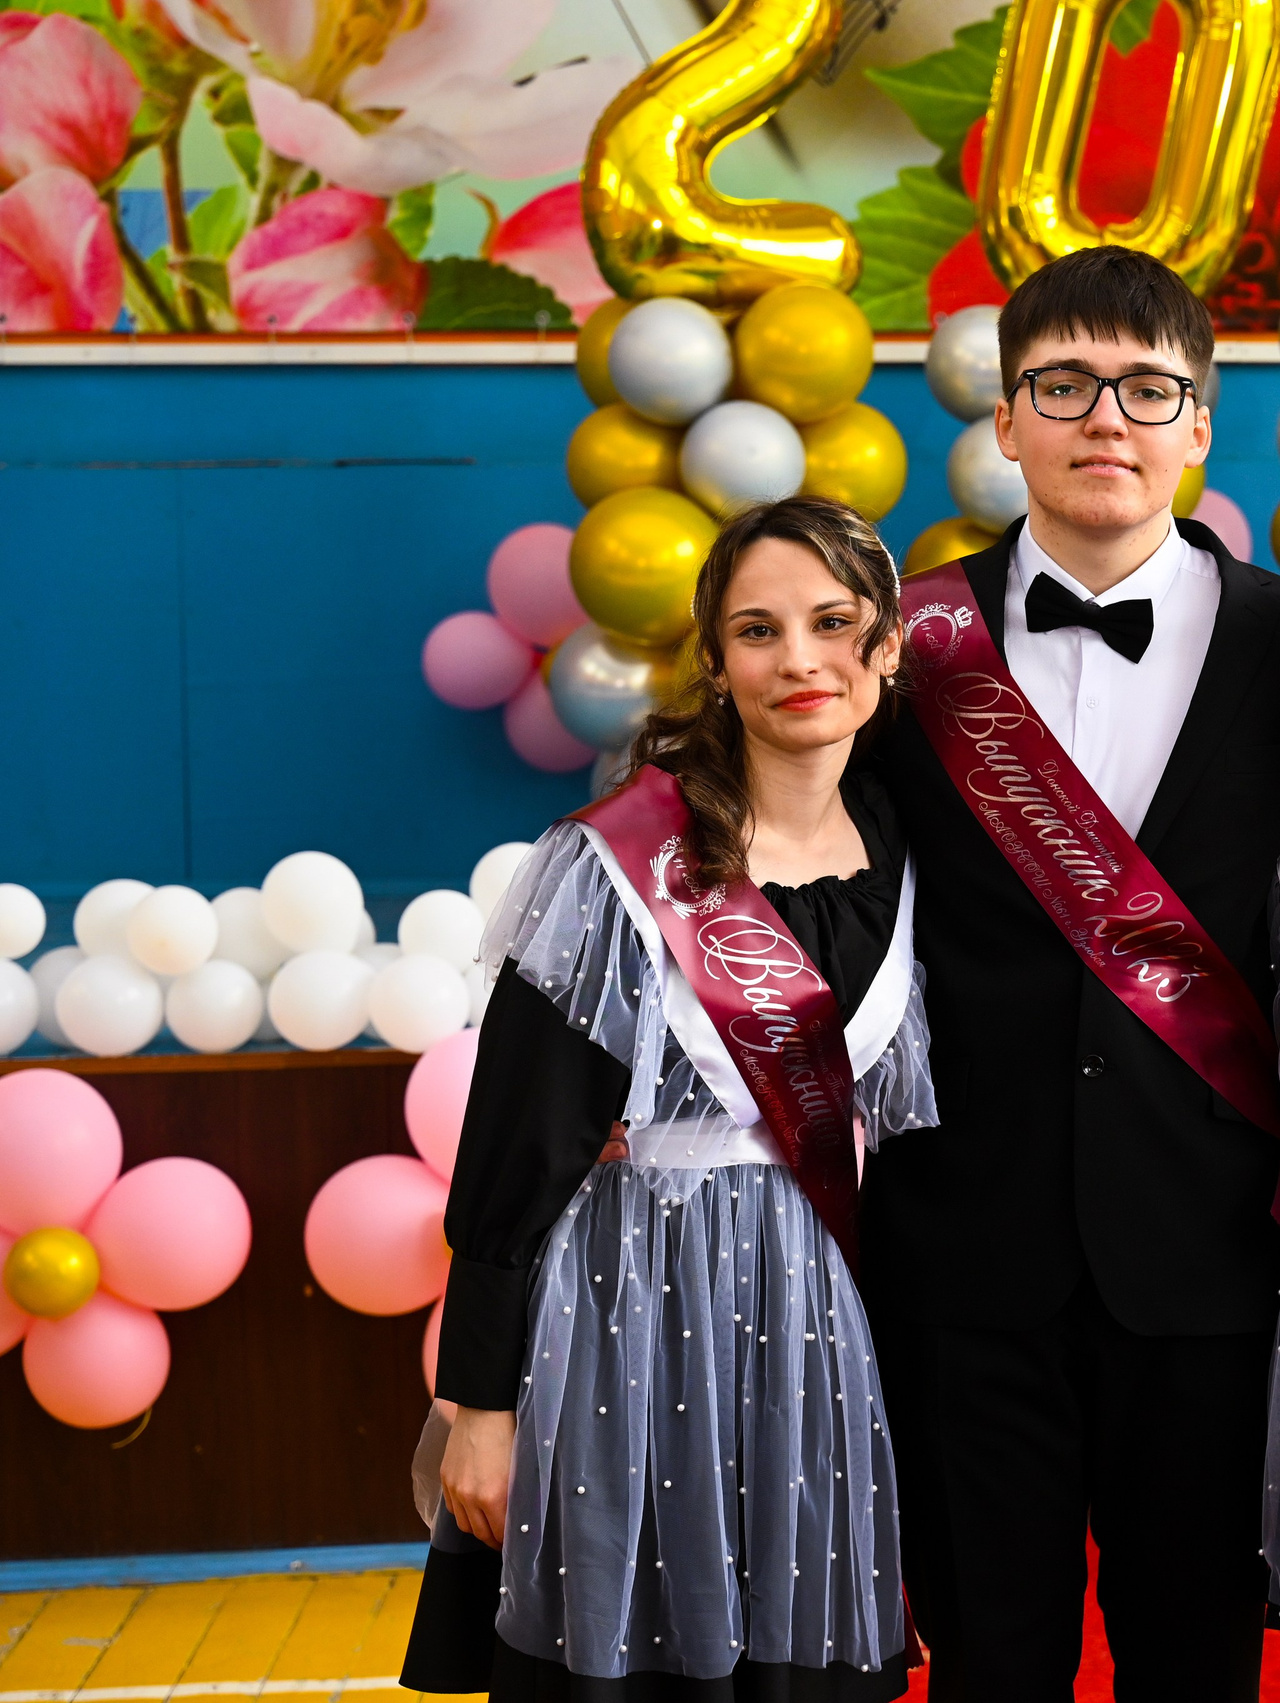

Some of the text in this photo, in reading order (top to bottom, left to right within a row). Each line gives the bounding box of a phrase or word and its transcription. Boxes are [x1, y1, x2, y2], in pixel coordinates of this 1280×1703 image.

[936, 671, 1210, 1003] Выпускник 2023
[1037, 759, 1126, 874] Донской Дмитрий
[1070, 927, 1106, 967] Узловая
